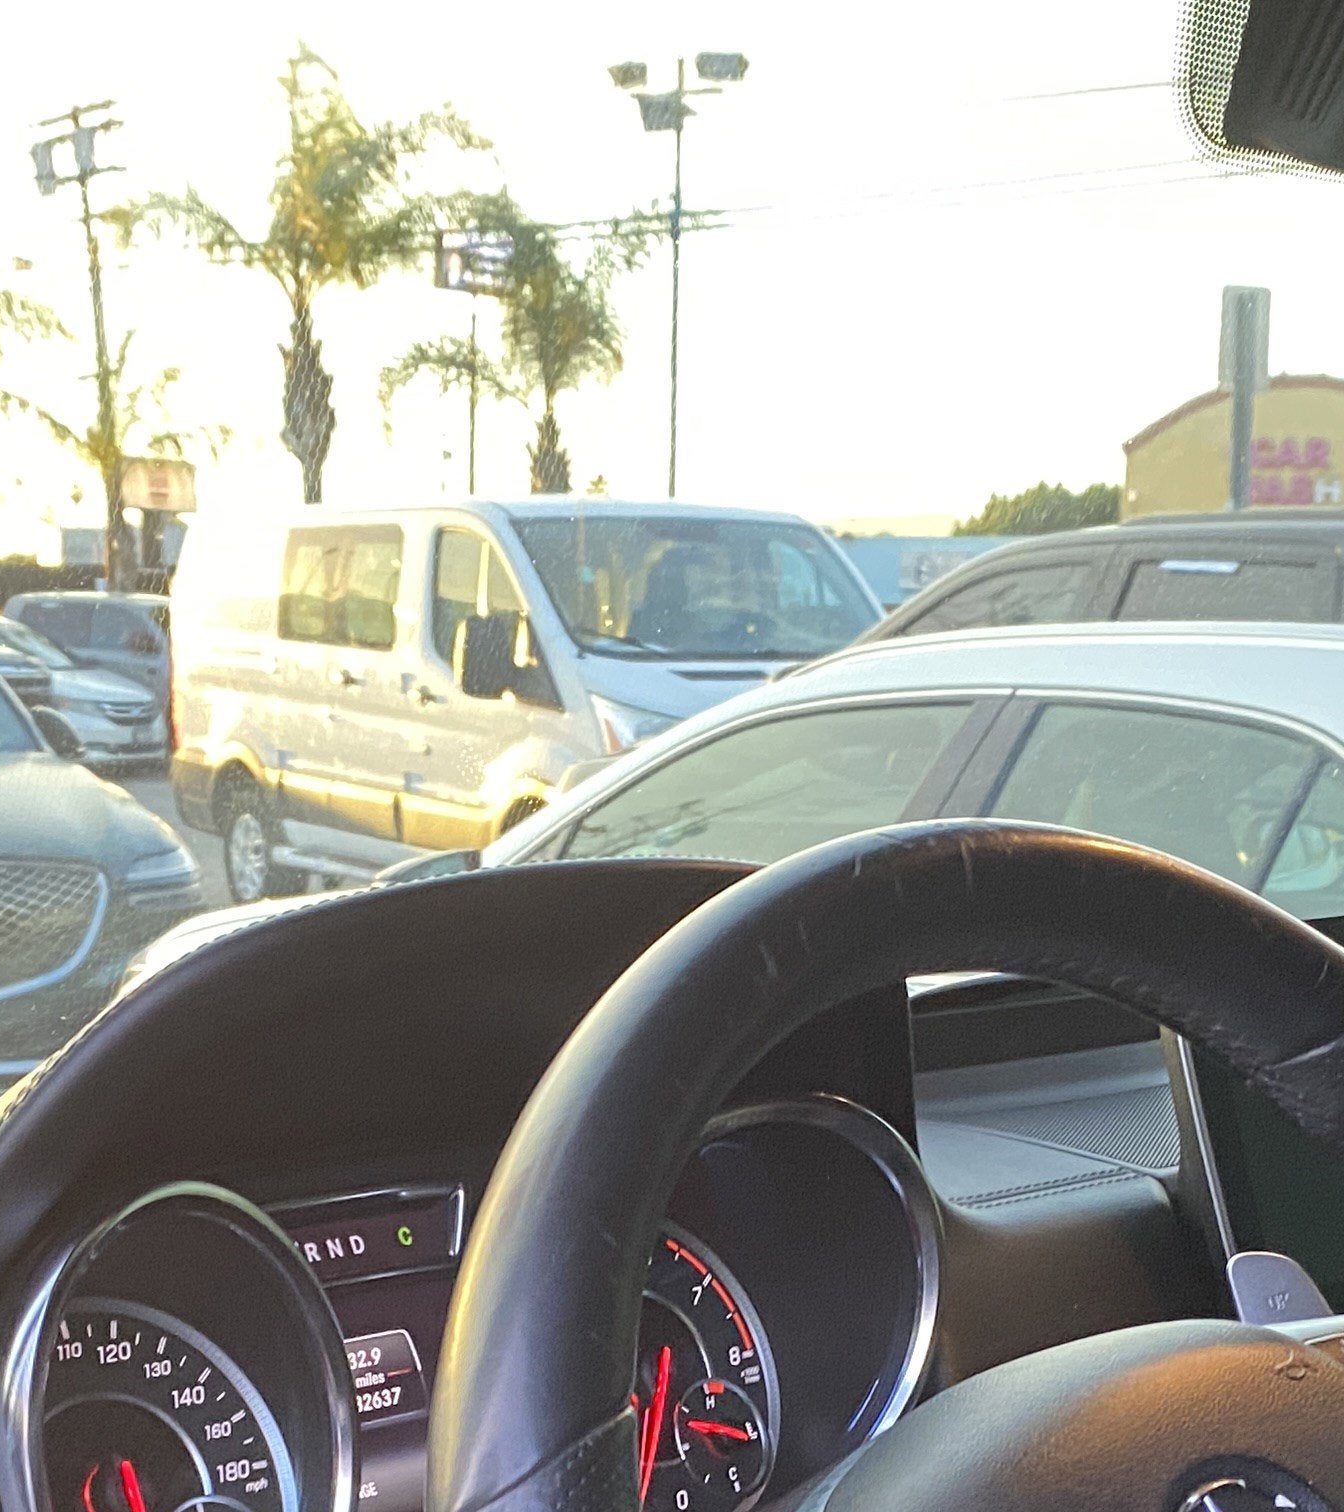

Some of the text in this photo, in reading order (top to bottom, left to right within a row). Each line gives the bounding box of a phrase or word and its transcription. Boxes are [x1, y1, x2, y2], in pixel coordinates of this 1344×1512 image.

[691, 1285, 703, 1306] 7
[56, 1342, 83, 1361] 110
[97, 1341, 132, 1365] 120
[728, 1345, 741, 1366] 8
[143, 1359, 173, 1379] 130
[171, 1385, 206, 1408] 140
[204, 1420, 233, 1440] 160
[216, 1459, 251, 1483] 180
[245, 1477, 269, 1494] mph
[676, 1489, 689, 1511] 0
